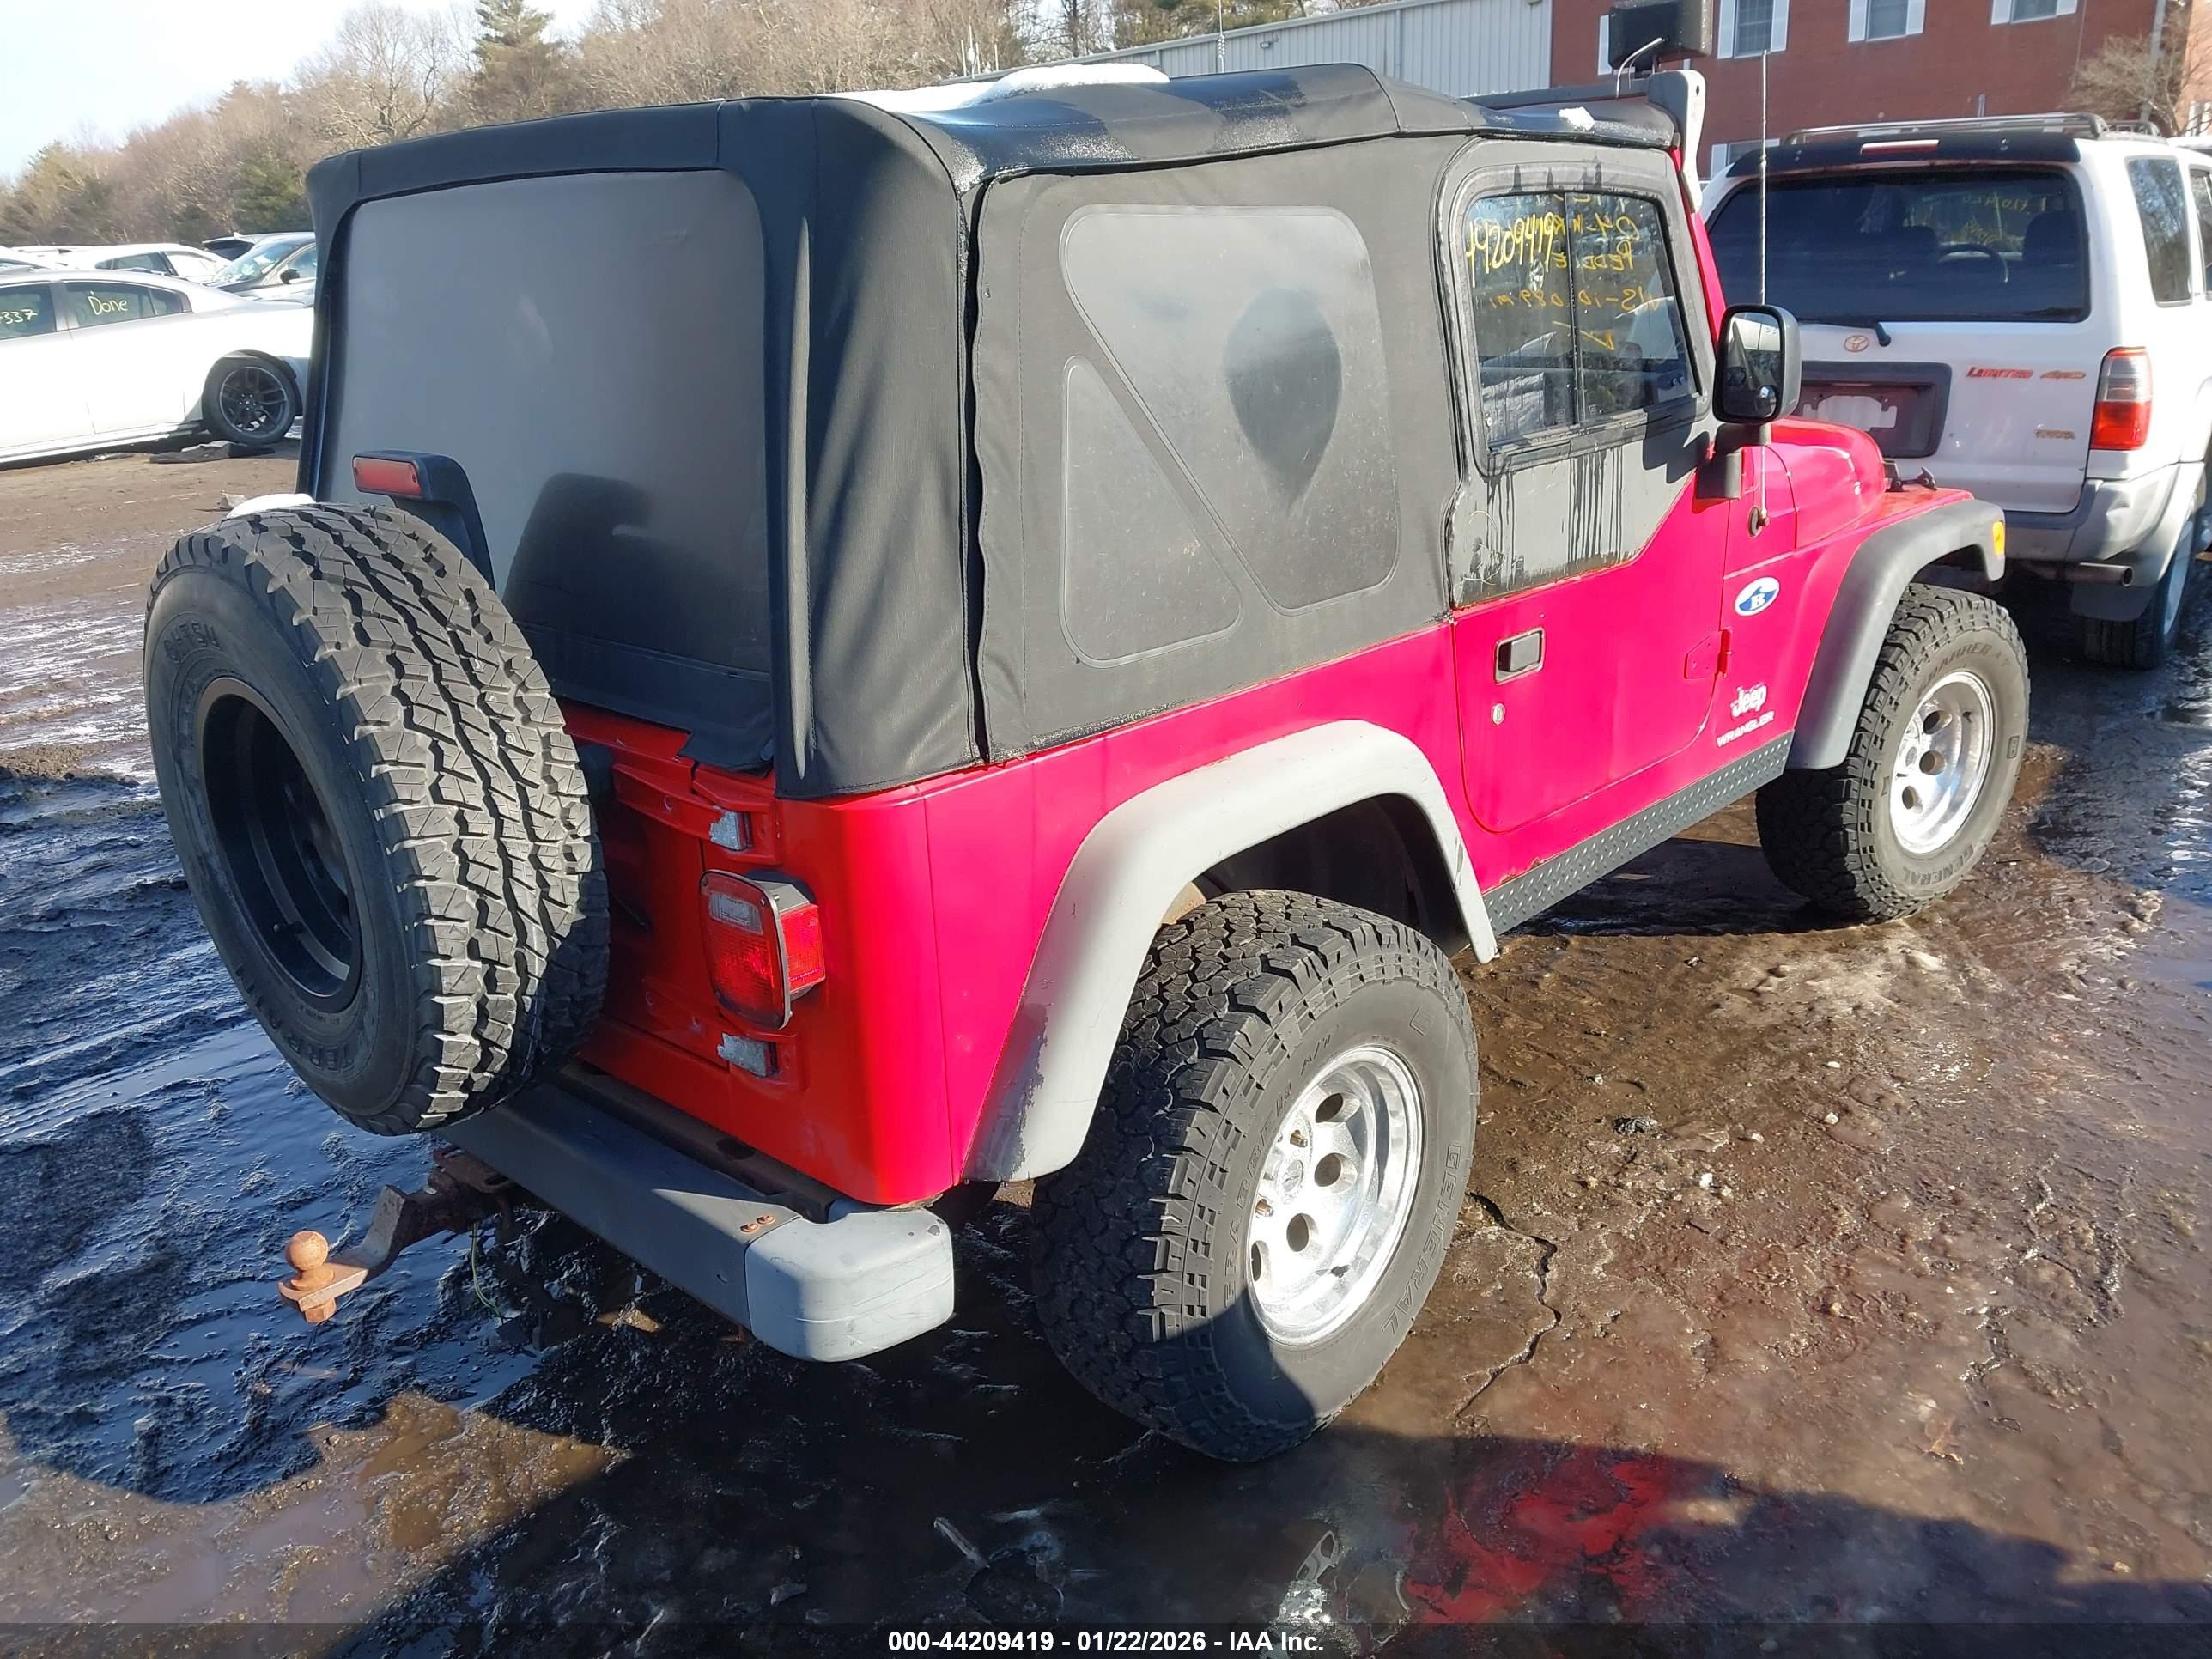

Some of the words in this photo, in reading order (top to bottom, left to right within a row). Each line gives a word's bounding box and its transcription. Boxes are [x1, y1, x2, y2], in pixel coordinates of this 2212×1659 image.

[1466, 211, 1554, 289] 44209419
[88, 295, 128, 316] Done
[1730, 683, 1767, 717] Jeep
[1717, 711, 1775, 748] WRANGLER
[1380, 1145, 1462, 1334] GENERAL
